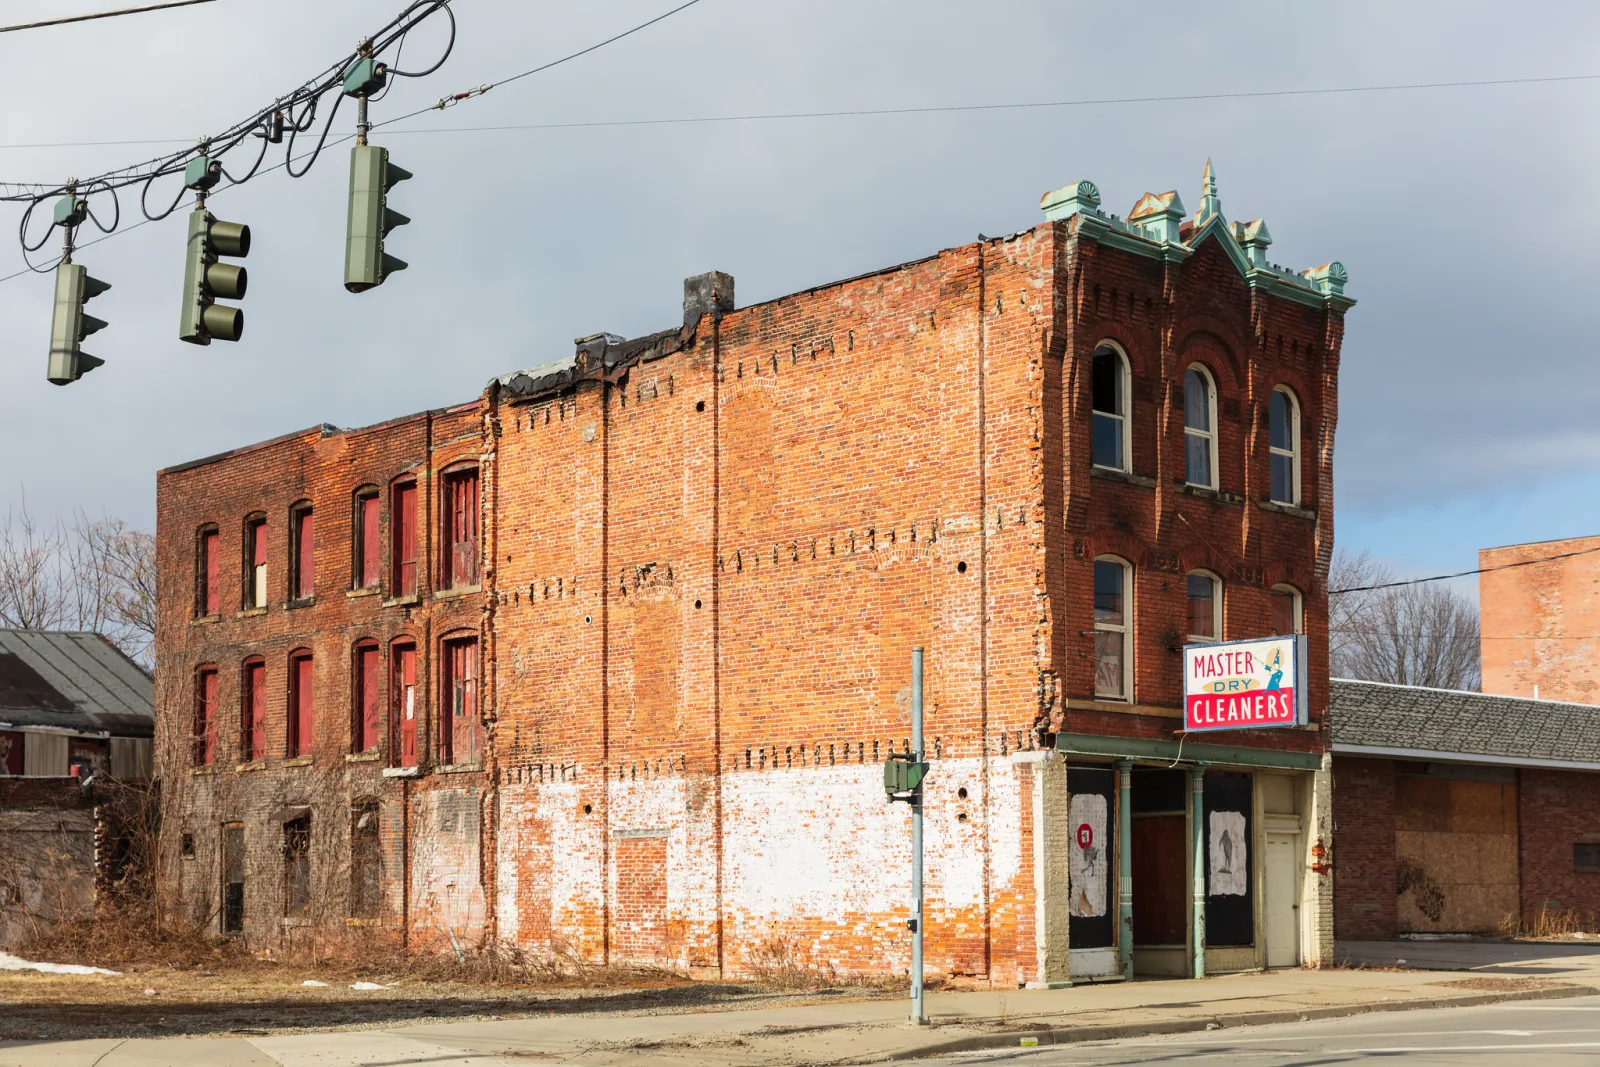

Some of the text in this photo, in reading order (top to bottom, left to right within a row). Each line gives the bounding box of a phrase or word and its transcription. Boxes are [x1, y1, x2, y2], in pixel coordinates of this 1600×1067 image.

[1194, 651, 1253, 678] MASTER
[1214, 679, 1252, 692] DRY
[1193, 694, 1288, 724] CLEANERS
